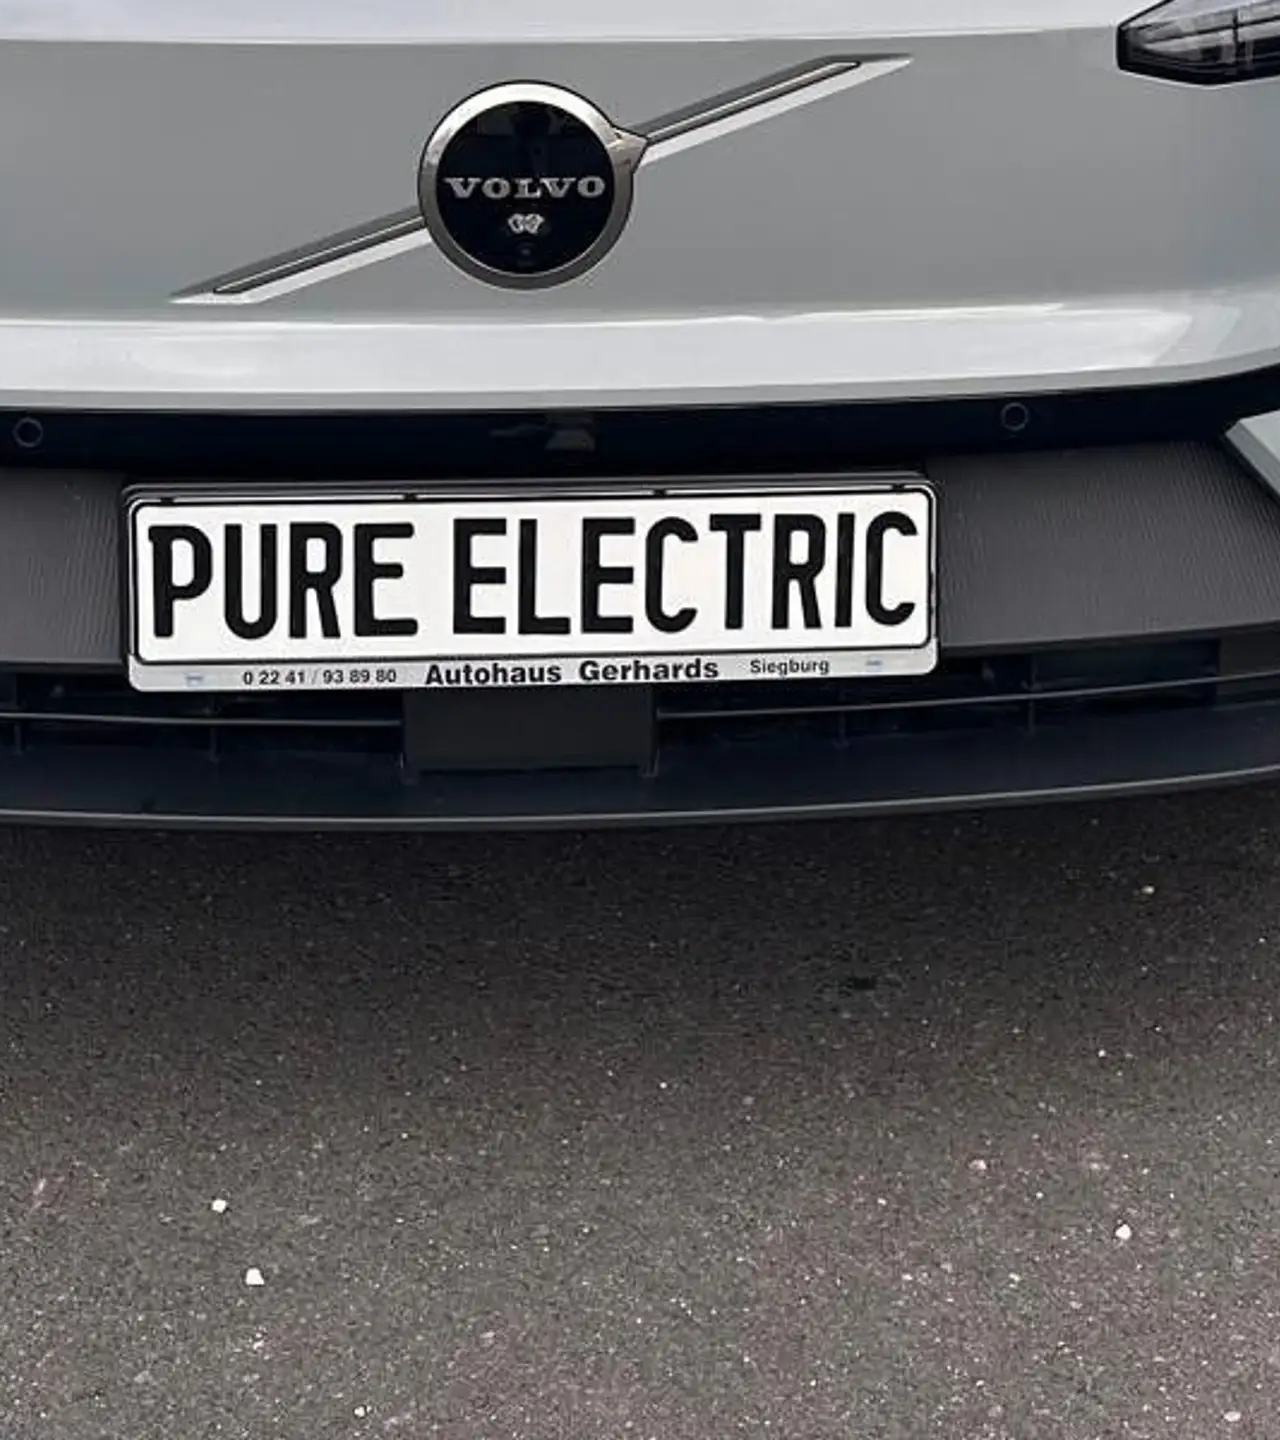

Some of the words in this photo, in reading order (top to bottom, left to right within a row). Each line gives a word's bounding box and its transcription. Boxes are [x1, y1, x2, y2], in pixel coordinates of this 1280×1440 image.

[443, 176, 606, 198] VOLVO
[147, 521, 420, 640] PURE
[451, 511, 919, 635] ELECTRIC
[424, 663, 563, 686] Autohaus
[579, 658, 719, 682] Gerhards
[749, 658, 831, 677] Siegburg
